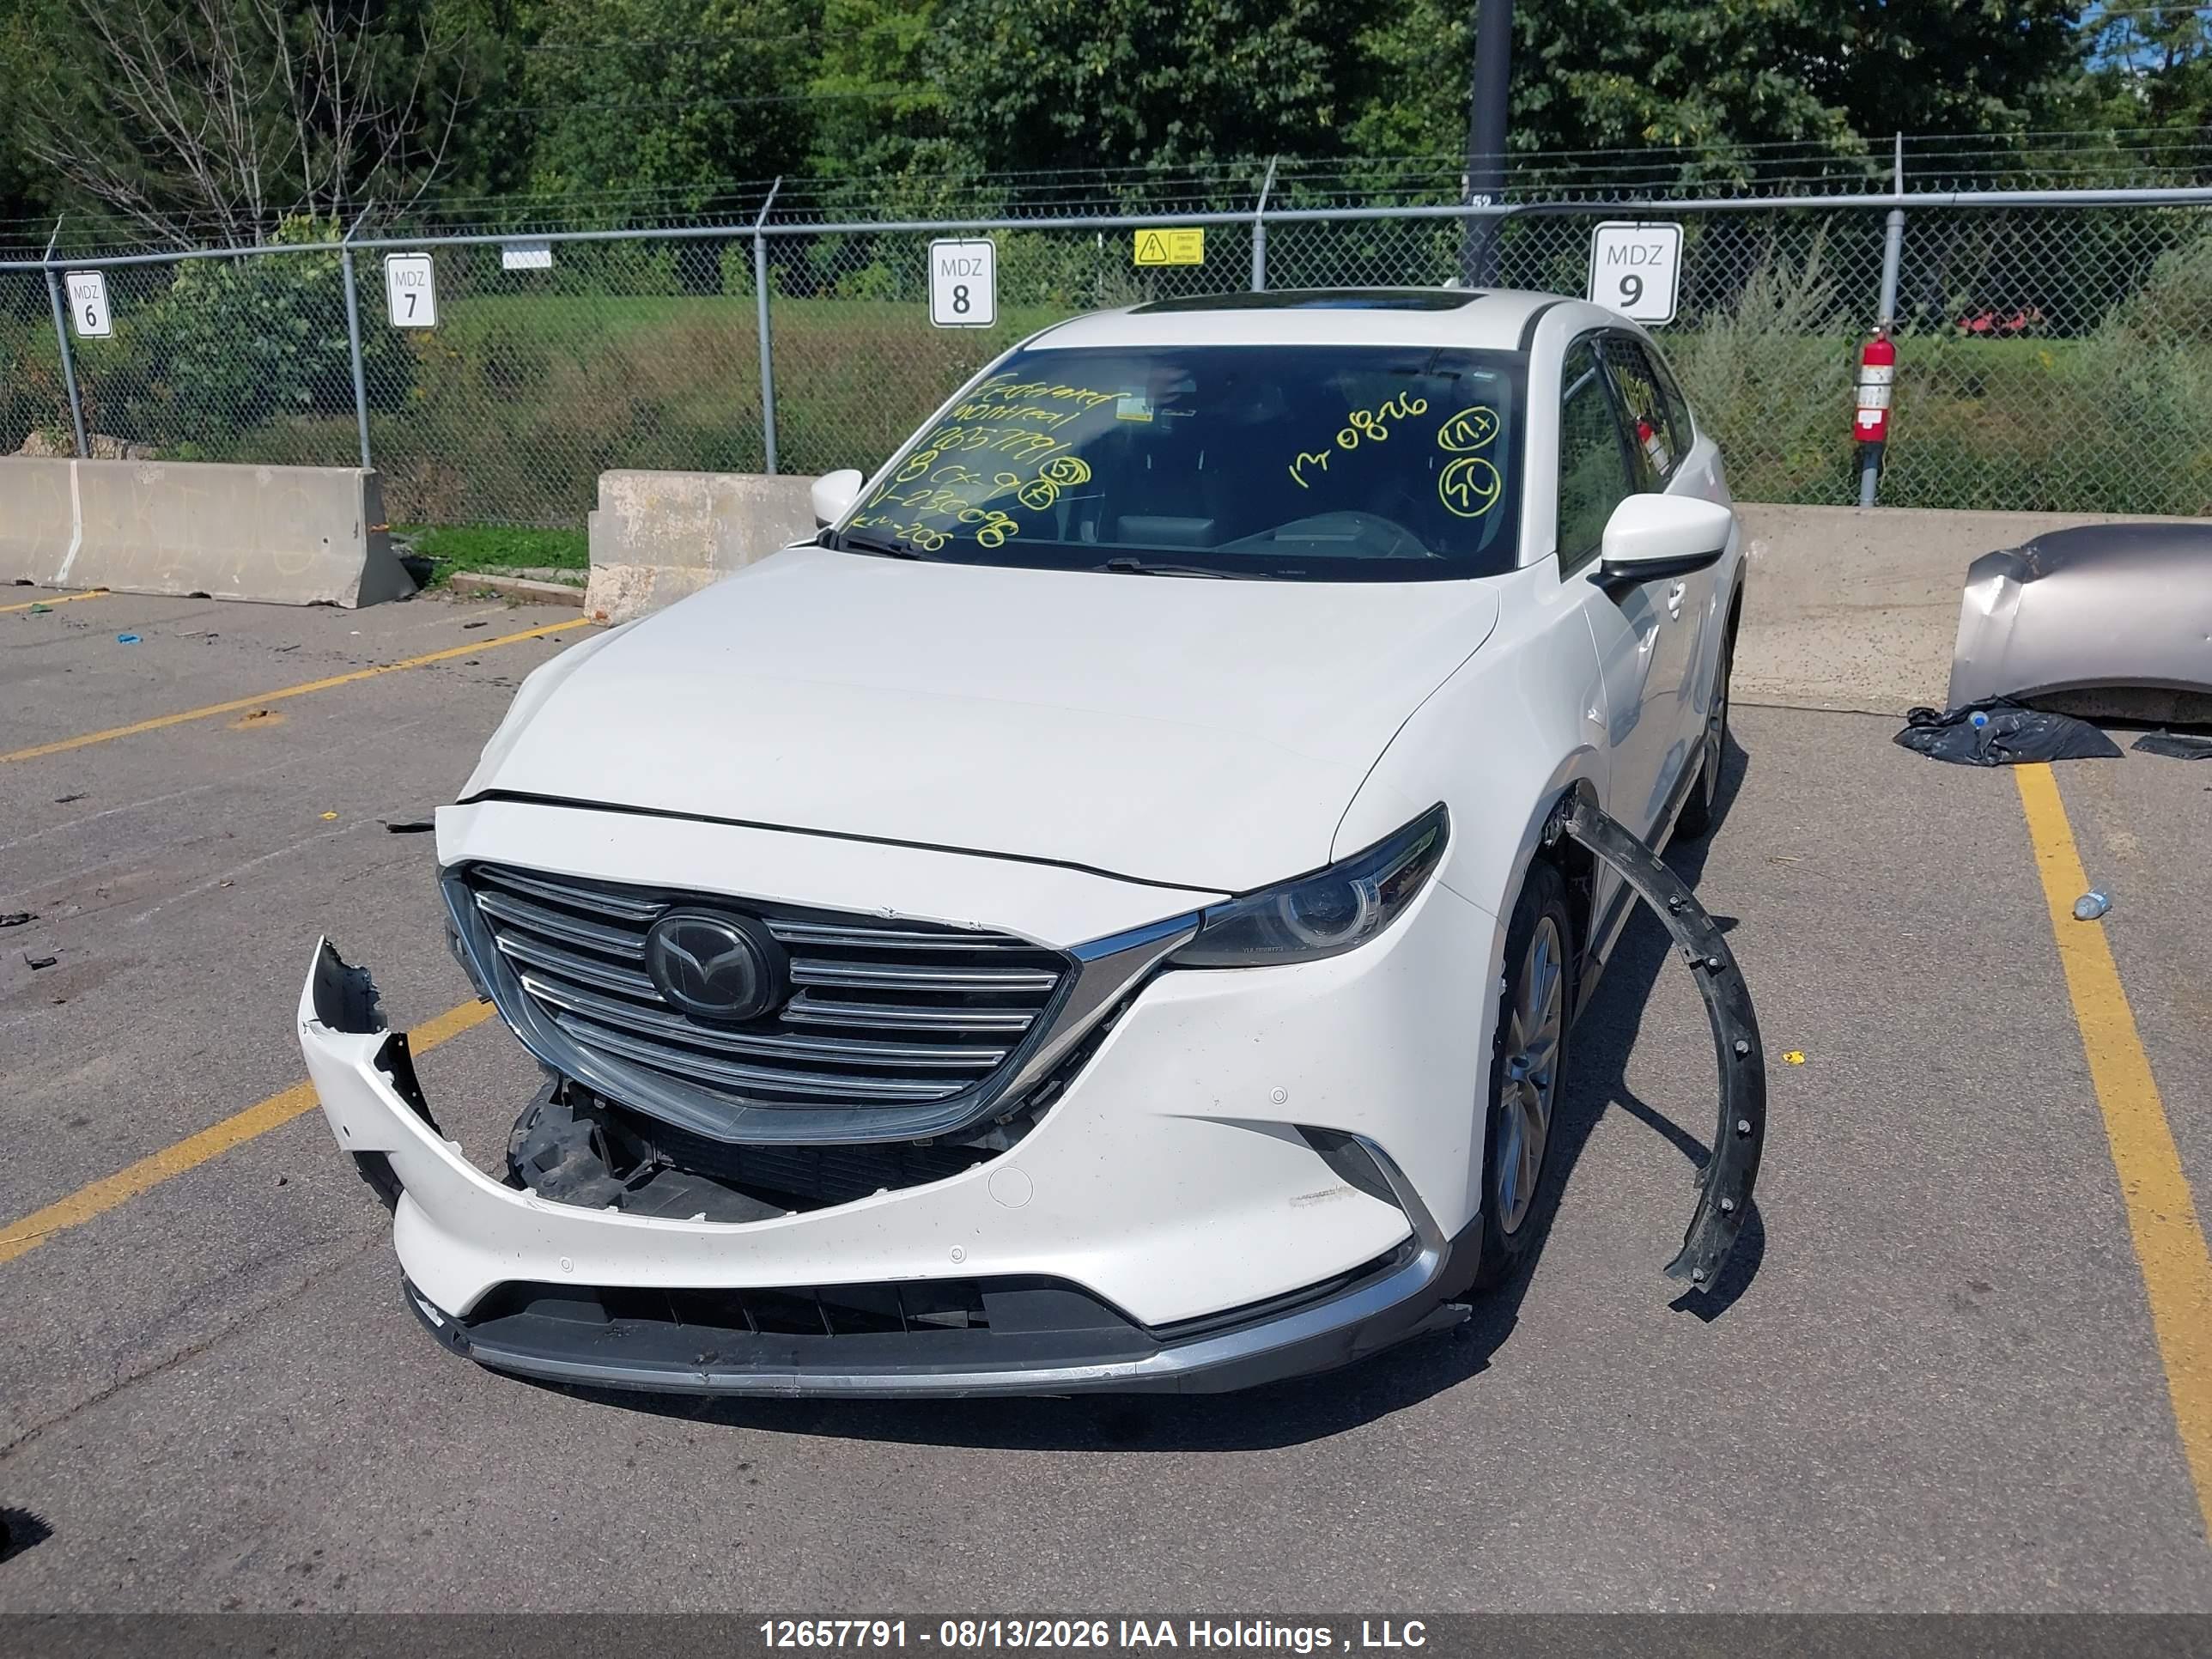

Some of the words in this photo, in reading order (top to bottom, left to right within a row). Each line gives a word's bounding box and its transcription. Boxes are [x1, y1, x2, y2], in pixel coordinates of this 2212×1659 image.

[1607, 245, 1663, 265] MDZ
[940, 258, 982, 277] MDZ
[395, 270, 425, 287] MDZ
[74, 284, 99, 300] MDZ
[952, 284, 970, 314] 8
[1620, 274, 1644, 307] 9
[85, 304, 97, 327] 6
[404, 293, 416, 318] 7
